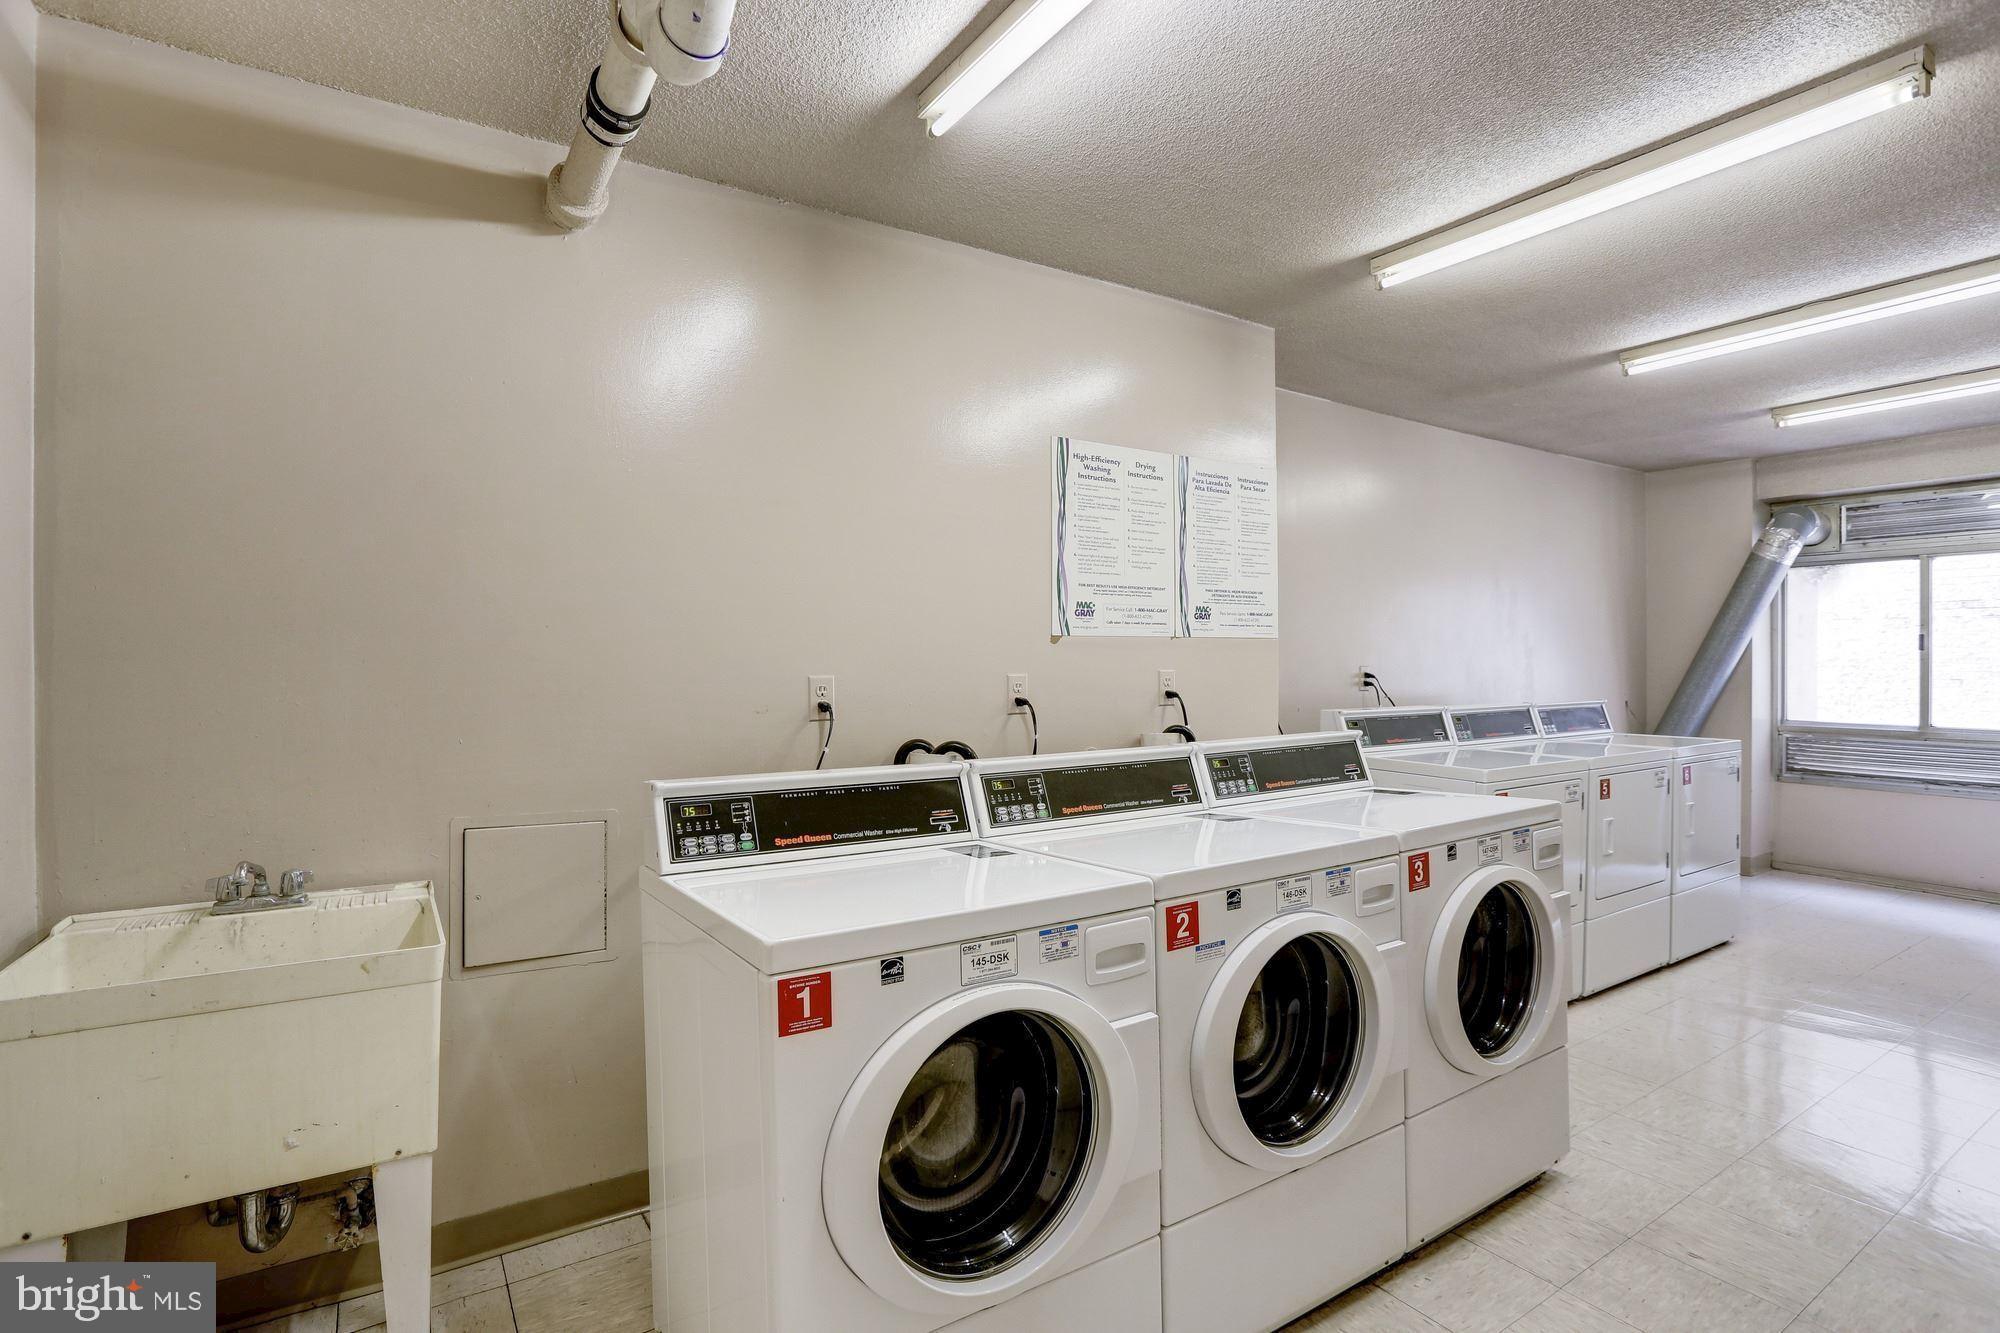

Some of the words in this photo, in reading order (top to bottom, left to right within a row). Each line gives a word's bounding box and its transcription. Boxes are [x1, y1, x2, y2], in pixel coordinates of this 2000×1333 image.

[1073, 453, 1121, 467] High-Efficiency
[1083, 463, 1111, 475] Washing
[1135, 461, 1156, 472] Drying
[1078, 472, 1116, 483] Instructions
[1127, 470, 1164, 481] Instructions
[1195, 470, 1229, 480] Instrucciones
[1192, 476, 1205, 484] Para
[1205, 479, 1223, 487] Lavada
[1237, 476, 1269, 486] Instrucciones
[1206, 486, 1230, 494] Eficiencia
[1075, 609, 1095, 617] GRAY
[994, 781, 1002, 789] 75
[1265, 781, 1281, 789] Speed
[1602, 783, 1608, 795] 5
[683, 806, 696, 816] 75
[1062, 806, 1082, 815] Speed
[1082, 804, 1103, 812] Queen
[774, 837, 803, 847] Speed
[803, 834, 832, 843] Queen
[833, 830, 864, 840] Commercial
[864, 829, 883, 837] Washer
[1414, 860, 1424, 882] 3
[1176, 912, 1190, 939] 2
[962, 944, 977, 952] CSC
[1200, 941, 1222, 951] NOTICE
[971, 951, 1010, 968] 145-DSK
[796, 986, 811, 1018] 1
